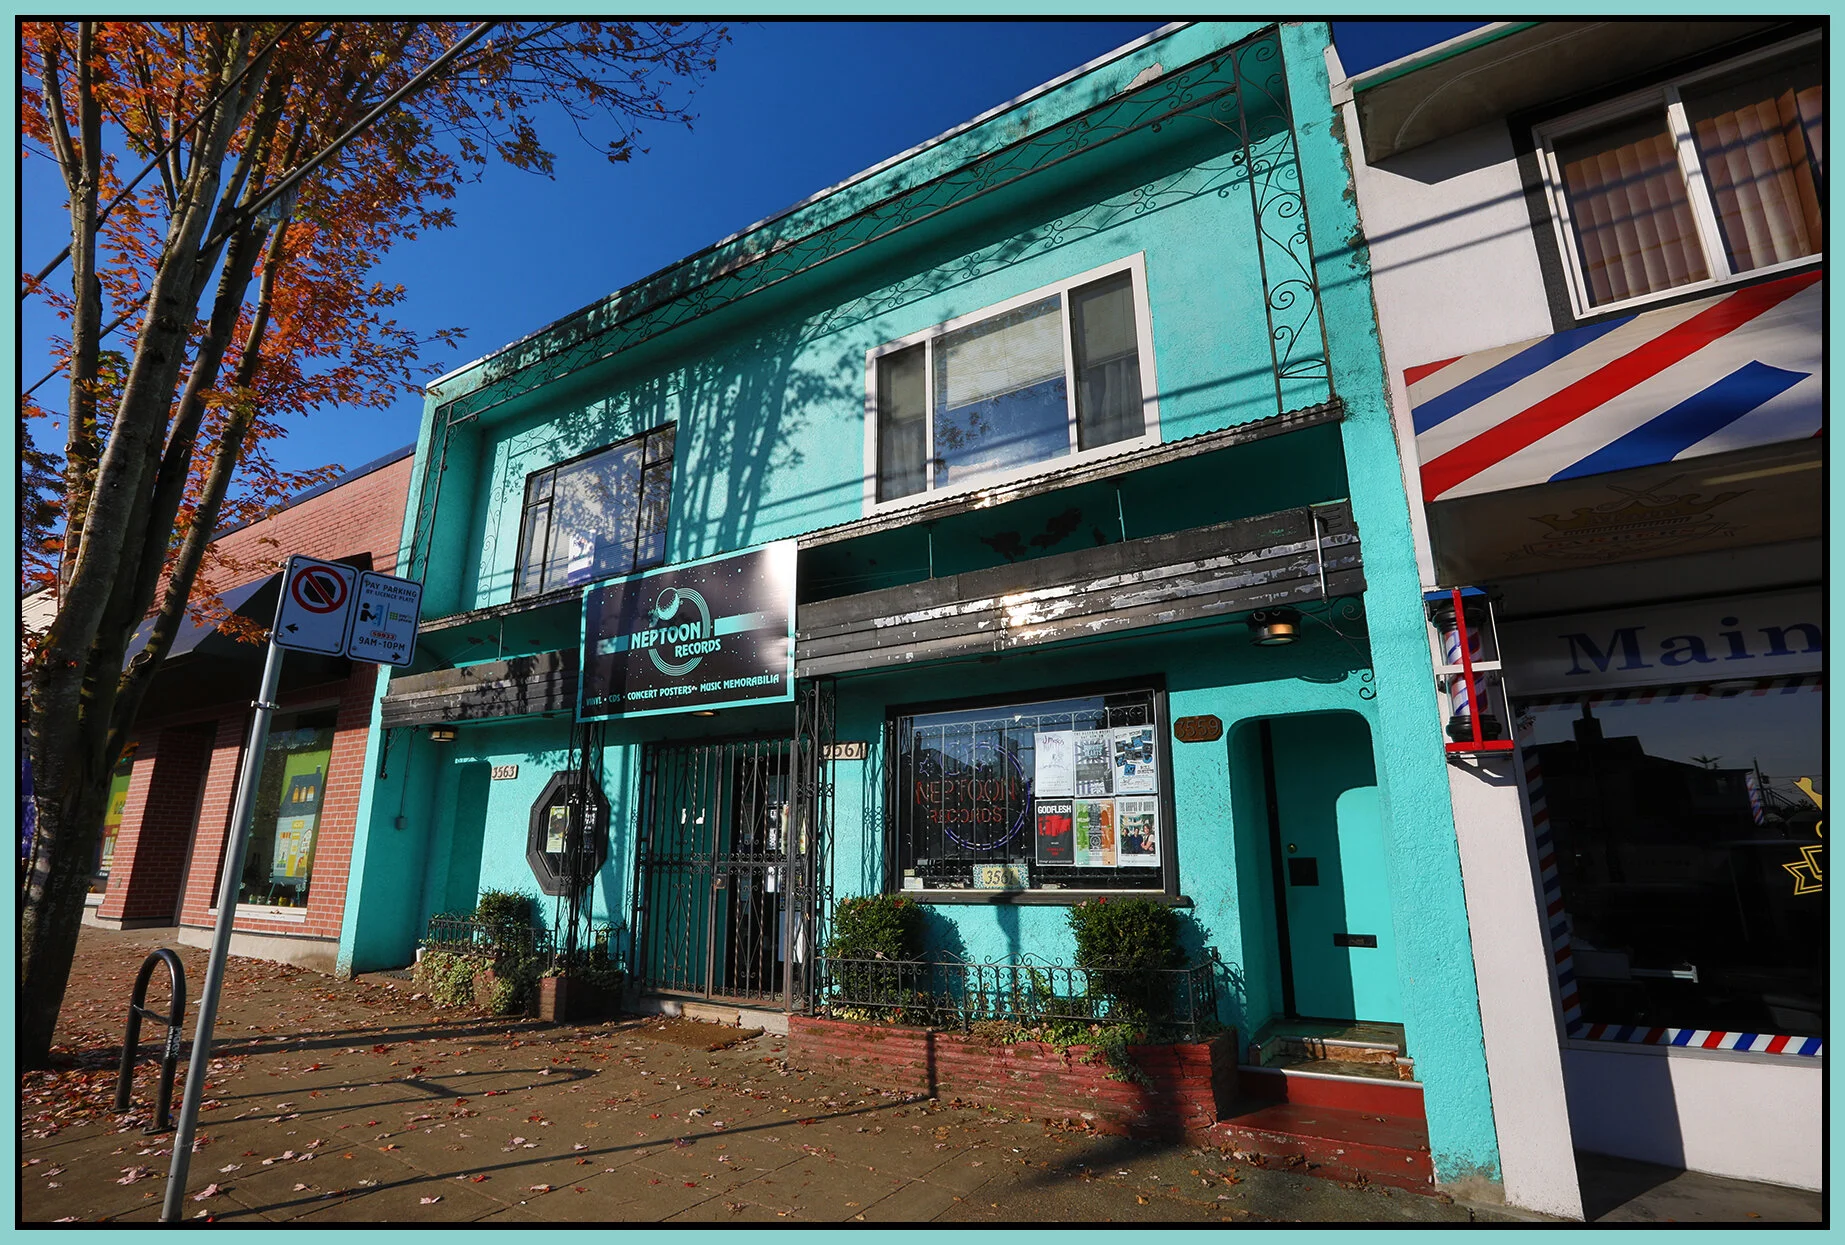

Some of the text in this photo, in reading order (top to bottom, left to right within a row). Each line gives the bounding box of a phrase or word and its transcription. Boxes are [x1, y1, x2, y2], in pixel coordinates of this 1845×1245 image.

[364, 580, 417, 598] PAY PARKING
[375, 590, 397, 599] LICENCE
[631, 622, 701, 650] NEPTOON
[675, 638, 721, 658] RECORDS
[1557, 616, 1823, 676] Main
[586, 673, 780, 707] VINYL CDS CONCERT POSTERS MUSIC MEMORABILIA
[1175, 717, 1220, 739] 3559
[491, 765, 516, 779] 3563
[915, 775, 1017, 805] NEPTOON
[929, 805, 1004, 824] RECORDS
[1037, 805, 1072, 814] GODFLESH
[984, 869, 1015, 886] 3561
